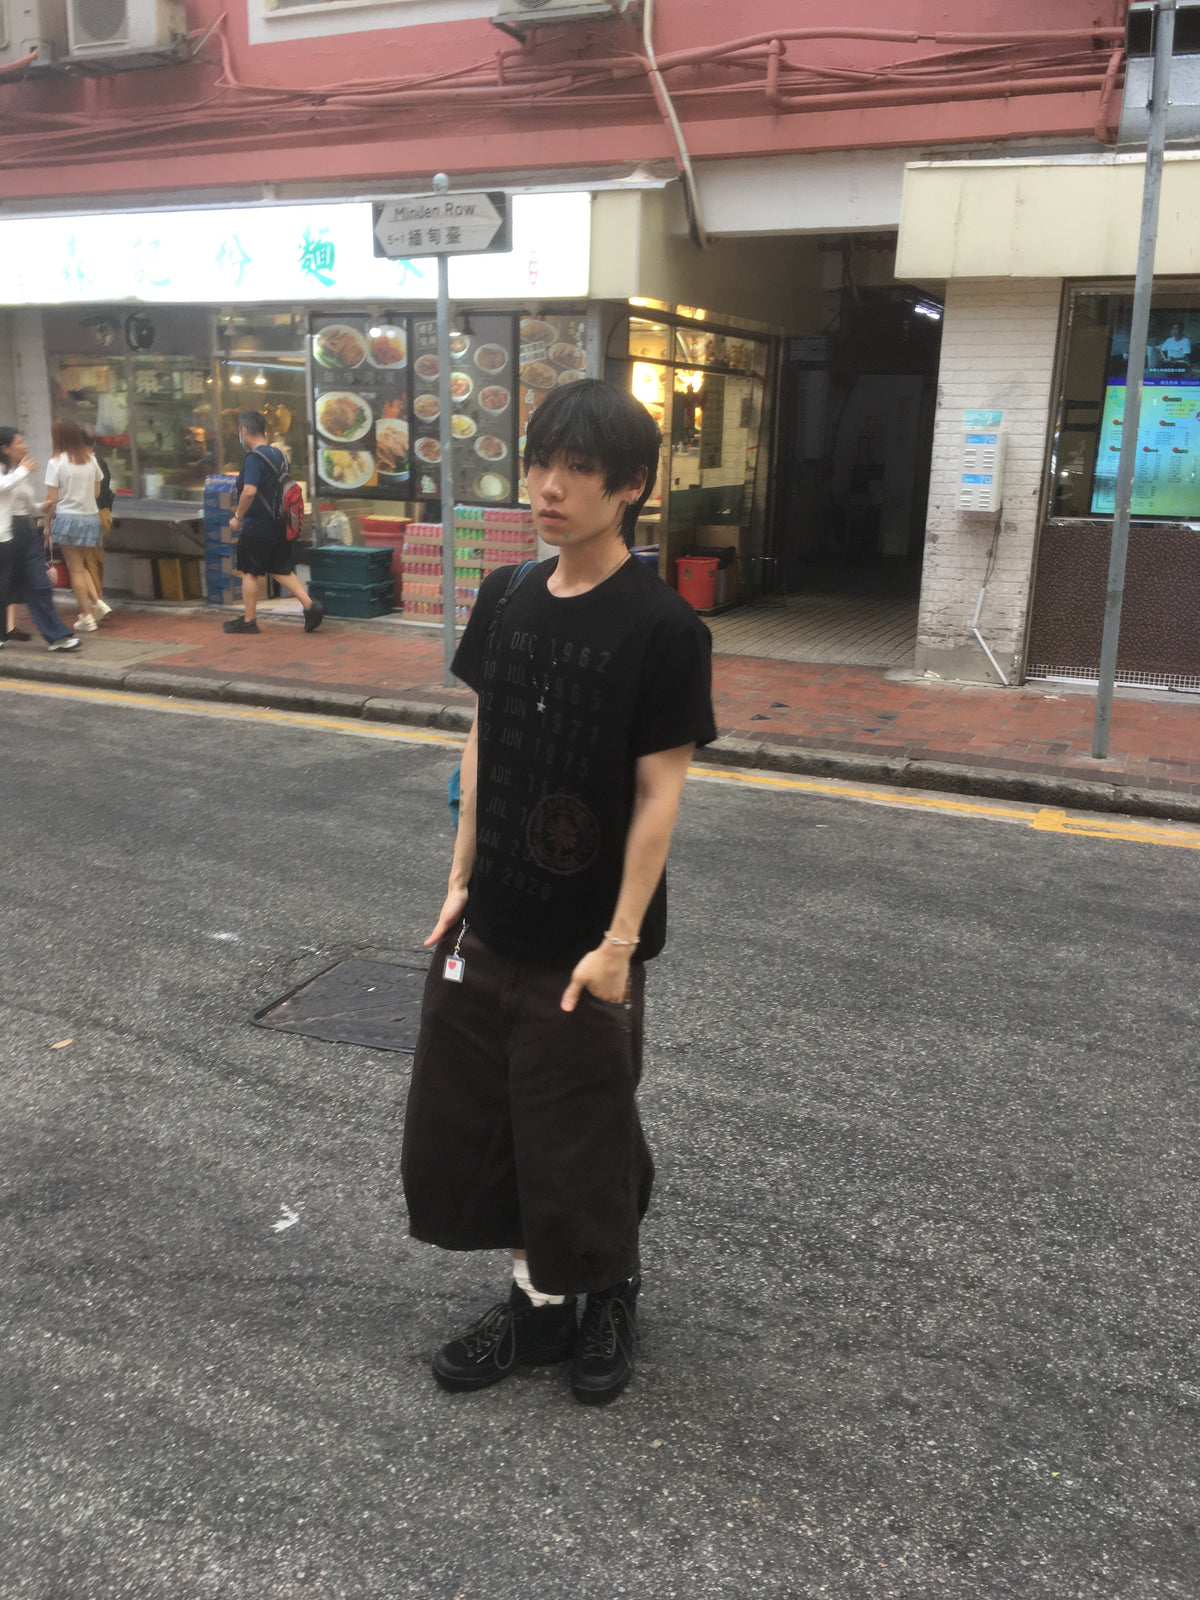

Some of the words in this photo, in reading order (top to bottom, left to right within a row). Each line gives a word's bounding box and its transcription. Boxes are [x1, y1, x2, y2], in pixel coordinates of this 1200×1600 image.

[394, 205, 441, 220] Minden
[445, 202, 476, 217] Row
[510, 631, 537, 655] DEC
[551, 637, 612, 672] 1962
[503, 664, 528, 688] JUL
[503, 696, 527, 719] JUN
[499, 727, 523, 751] JUN
[489, 765, 511, 786] AUG
[485, 796, 506, 819] JUL
[478, 826, 501, 849] JAN
[501, 867, 552, 901] 2020
